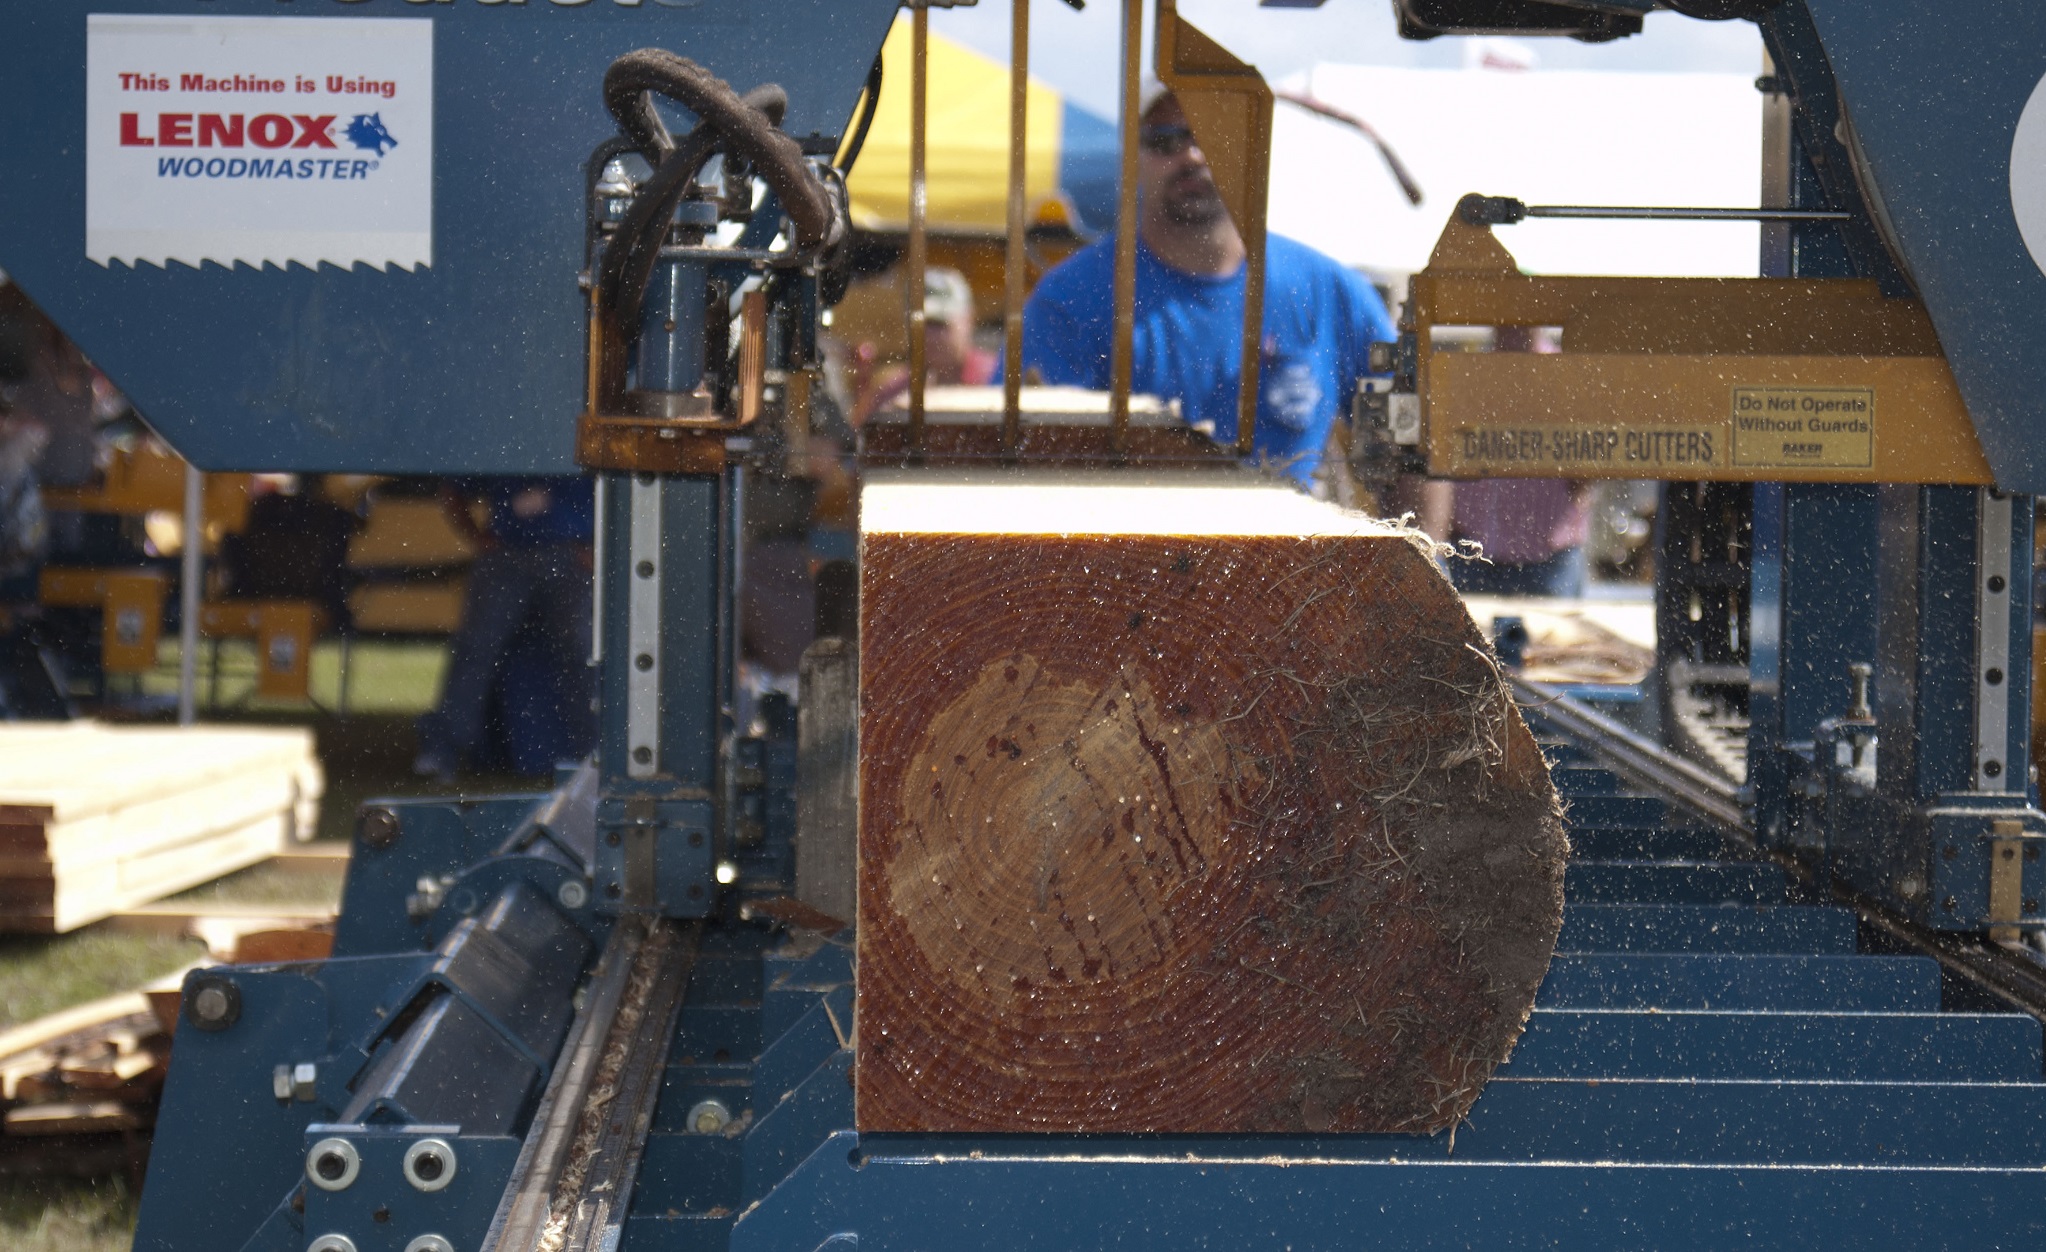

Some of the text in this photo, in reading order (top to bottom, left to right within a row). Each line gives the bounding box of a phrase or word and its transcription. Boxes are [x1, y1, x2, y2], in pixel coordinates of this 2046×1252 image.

[119, 73, 396, 98] This Machine is Using
[1739, 396, 1867, 414] Do Not Operate
[1739, 417, 1868, 433] Without Guards
[1463, 428, 1713, 463] DANGER-SHARP CUTTERS
[1782, 443, 1823, 453] BAKER
